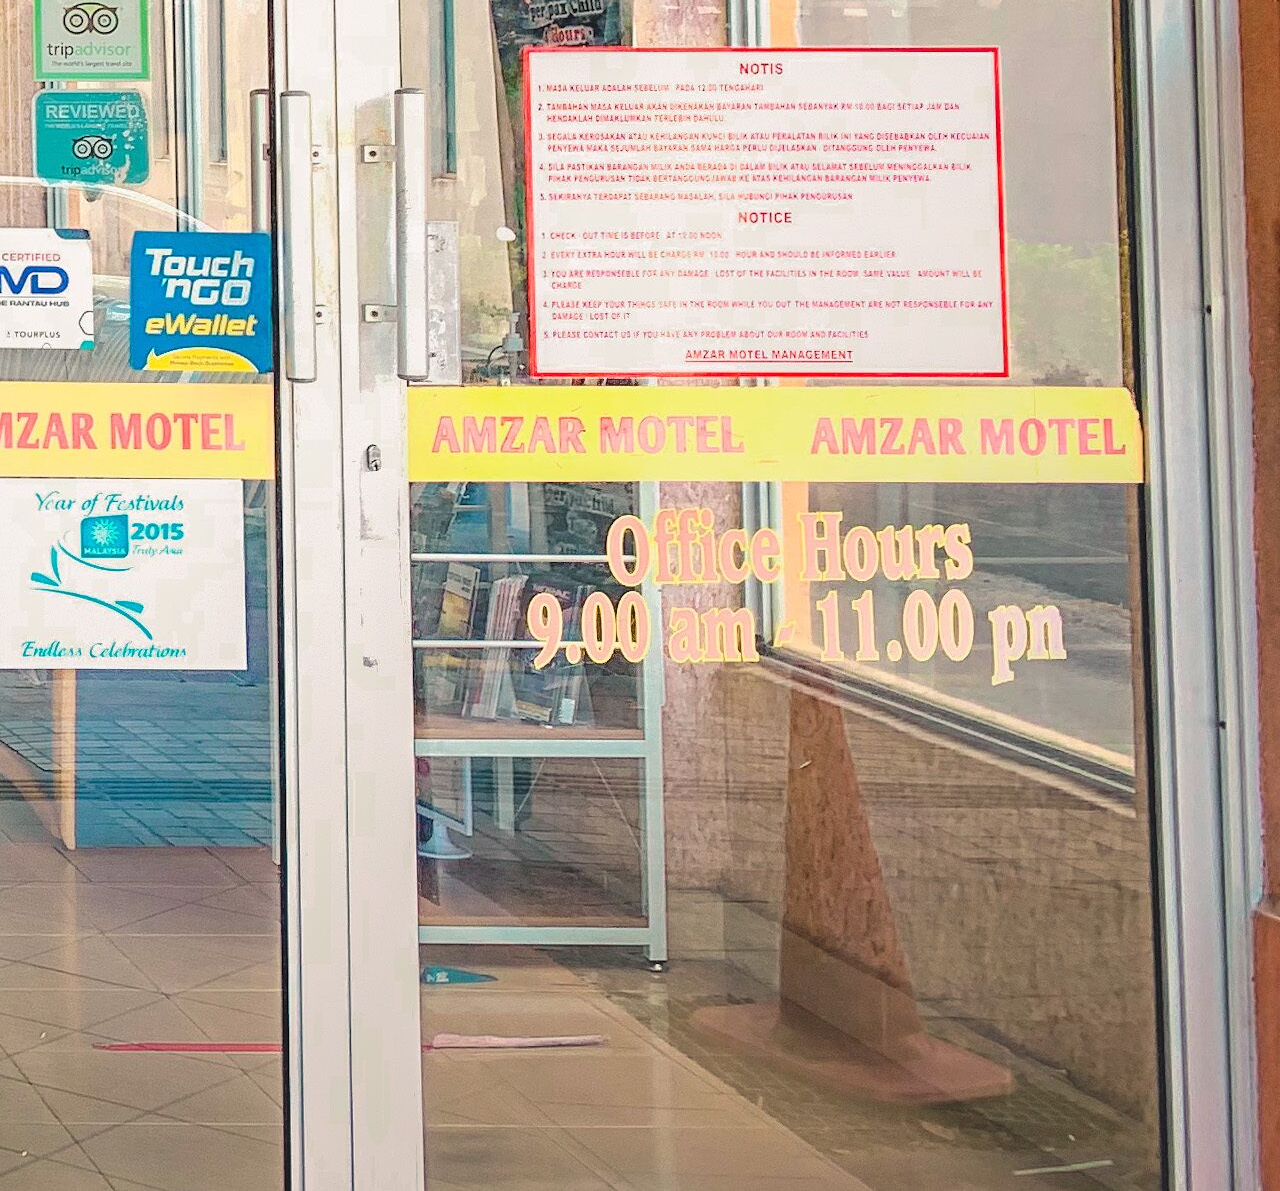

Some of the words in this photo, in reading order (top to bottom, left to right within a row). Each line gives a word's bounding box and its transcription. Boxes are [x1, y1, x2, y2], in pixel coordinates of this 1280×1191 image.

[47, 42, 132, 59] tripadvisor
[740, 63, 783, 75] NOTIS
[46, 105, 139, 119] REVIEWED
[738, 212, 792, 224] NOTICE
[1, 253, 61, 262] CERTIFIED
[145, 248, 255, 278] Touch
[144, 312, 259, 337] eWallet
[14, 331, 61, 339] TOURPLUS
[552, 331, 581, 339] PLEASE
[583, 331, 618, 339] CONTACT
[685, 350, 726, 359] AMZAR
[729, 349, 768, 359] MOTEL
[771, 349, 853, 360] MANAGEMENT
[110, 413, 246, 451] MOTEL
[431, 416, 585, 455] AMZAR
[599, 416, 745, 454] MOTEL
[810, 417, 965, 456] AMZAR
[980, 418, 1127, 456] MOTEL
[35, 490, 76, 511] Year
[81, 492, 103, 517] of
[104, 493, 184, 512] Festivals
[130, 522, 184, 541] 2015
[83, 547, 127, 555] MALAYSIA
[605, 506, 783, 588] Office
[799, 512, 973, 583] Hours
[526, 591, 650, 671] 9.00
[668, 602, 760, 664] am
[816, 589, 975, 663] 11.00
[21, 640, 82, 658] Endless
[90, 640, 187, 658] Celebrations
